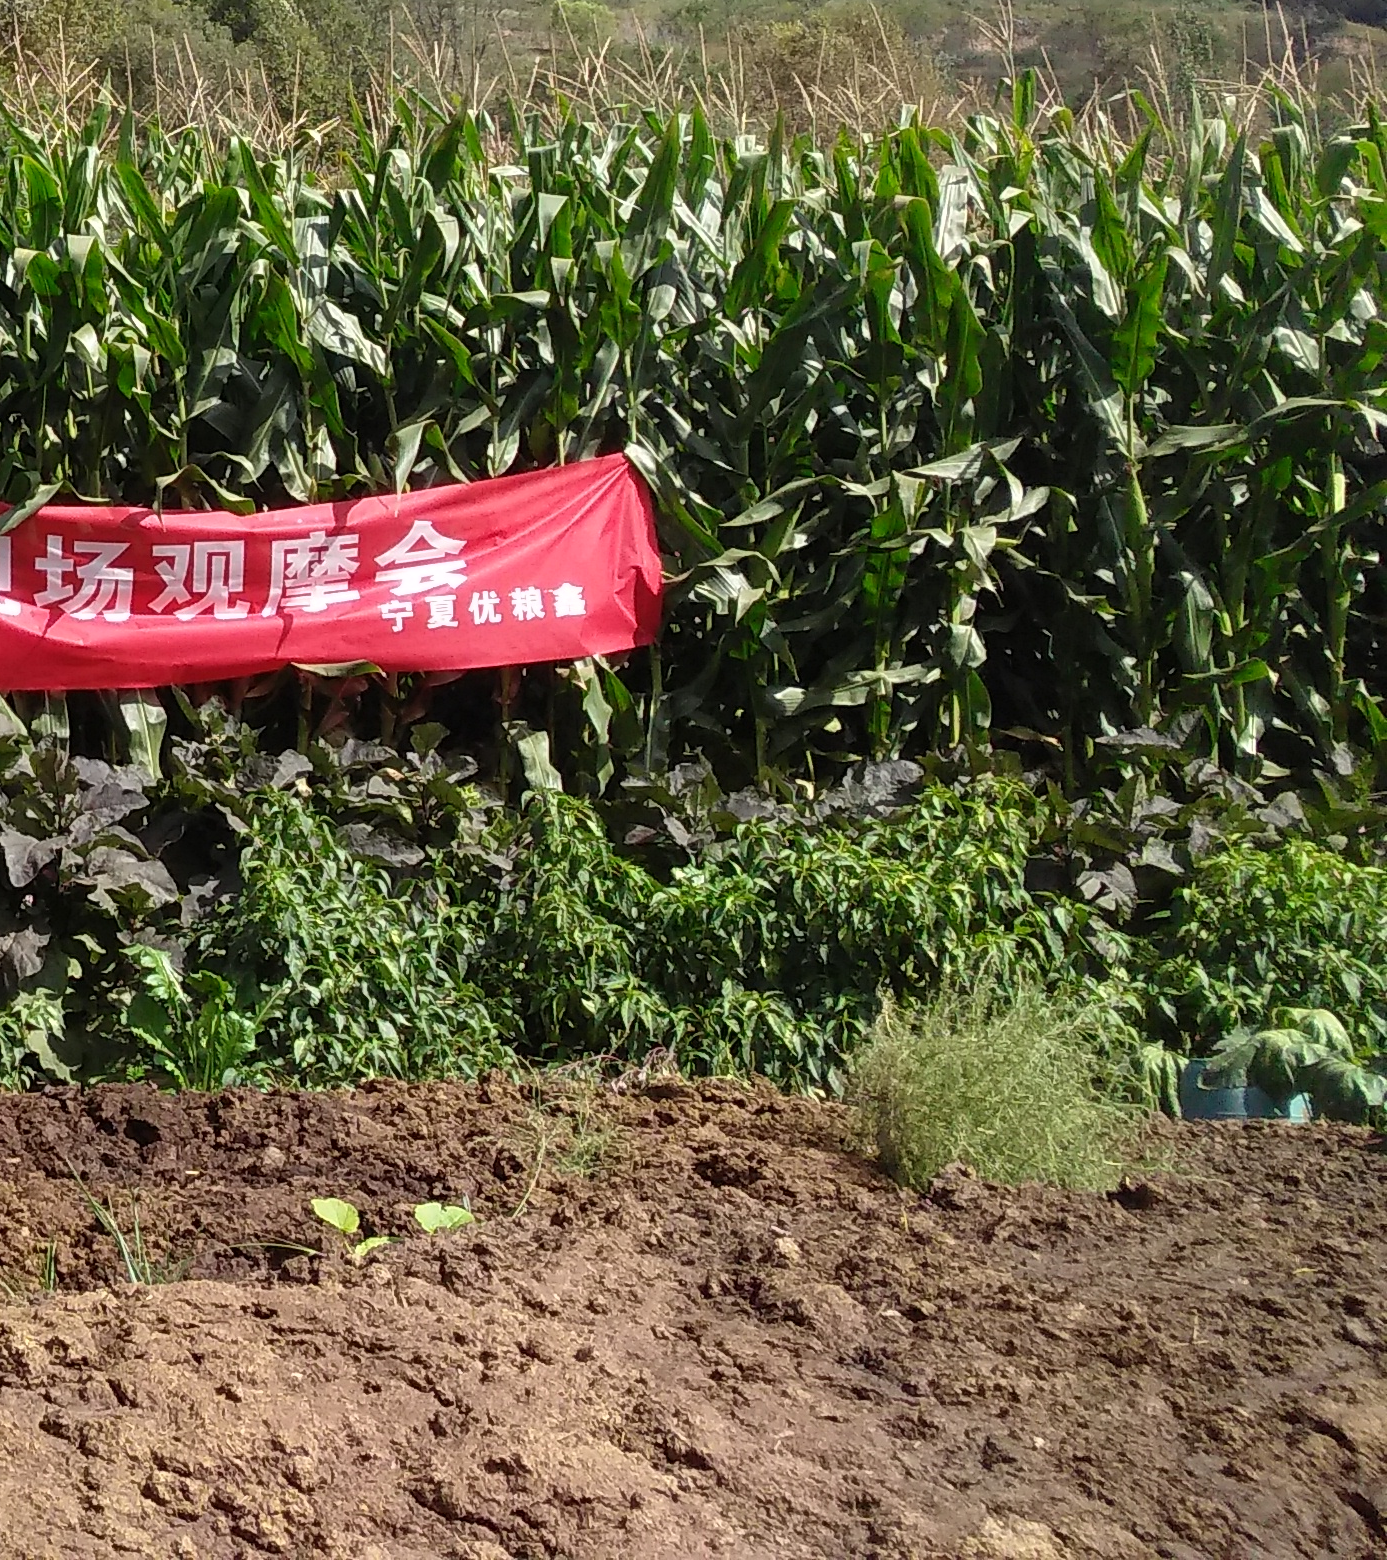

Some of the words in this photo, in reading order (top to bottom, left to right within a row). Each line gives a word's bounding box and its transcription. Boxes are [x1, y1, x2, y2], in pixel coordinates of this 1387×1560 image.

[377, 581, 588, 634] 宁夏优粮鑫
